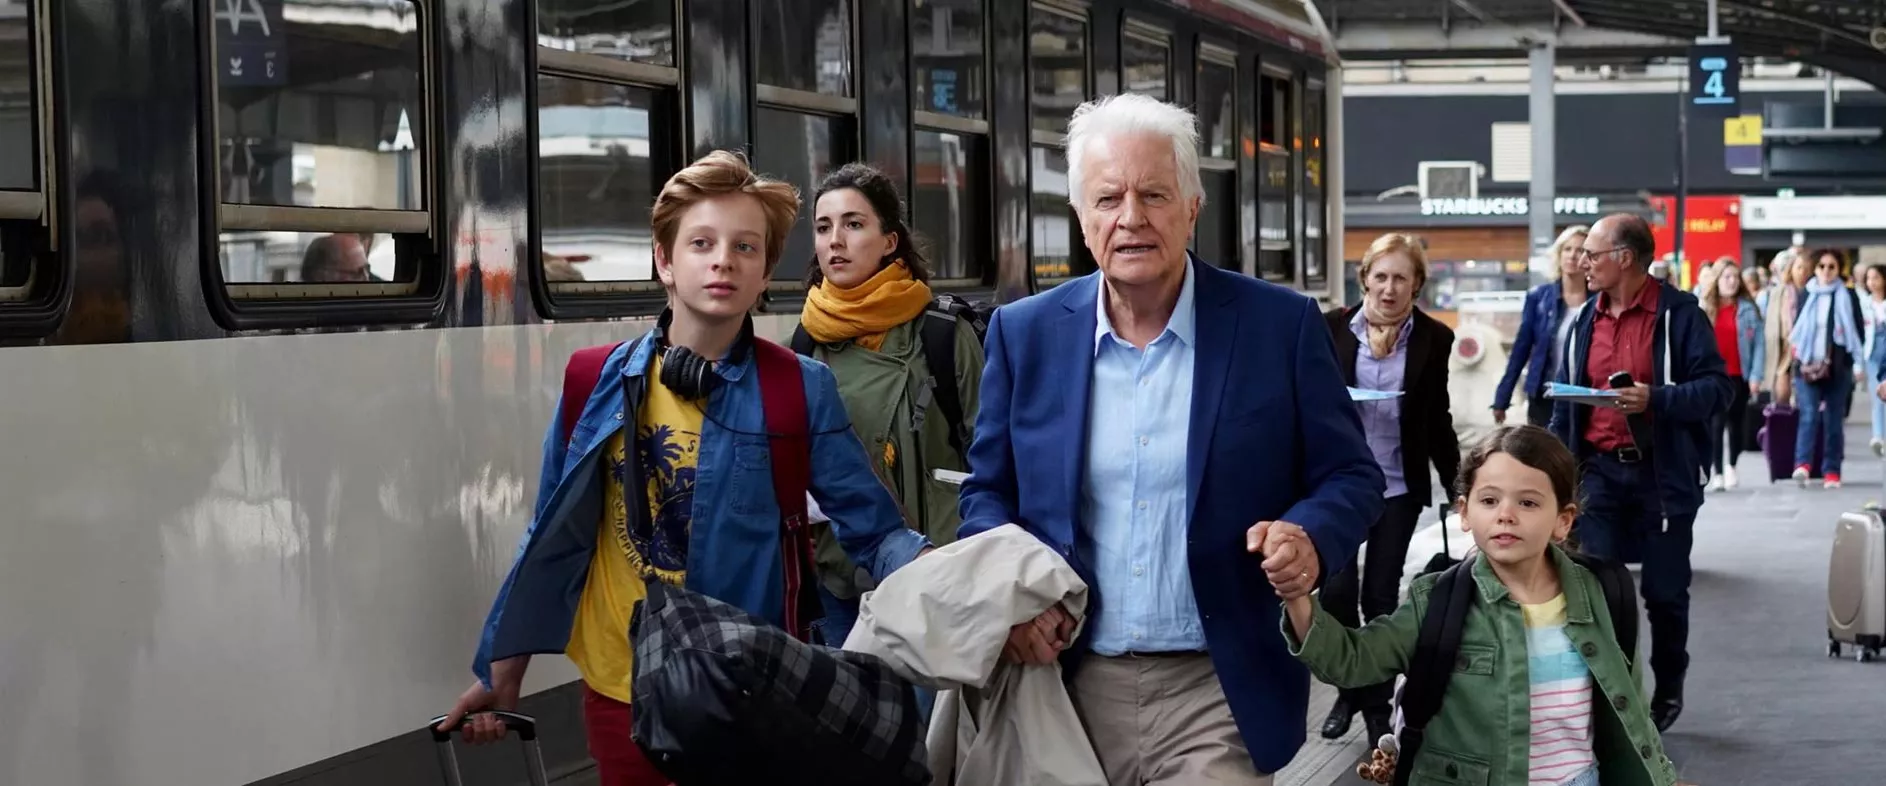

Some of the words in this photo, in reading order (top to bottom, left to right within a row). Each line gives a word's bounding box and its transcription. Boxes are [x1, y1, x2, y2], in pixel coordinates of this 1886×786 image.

[1704, 70, 1725, 97] 4
[1736, 122, 1747, 138] 4
[1421, 198, 1528, 215] STARBUCKS
[1554, 198, 1599, 214] FFEE
[1690, 218, 1727, 233] RELAY
